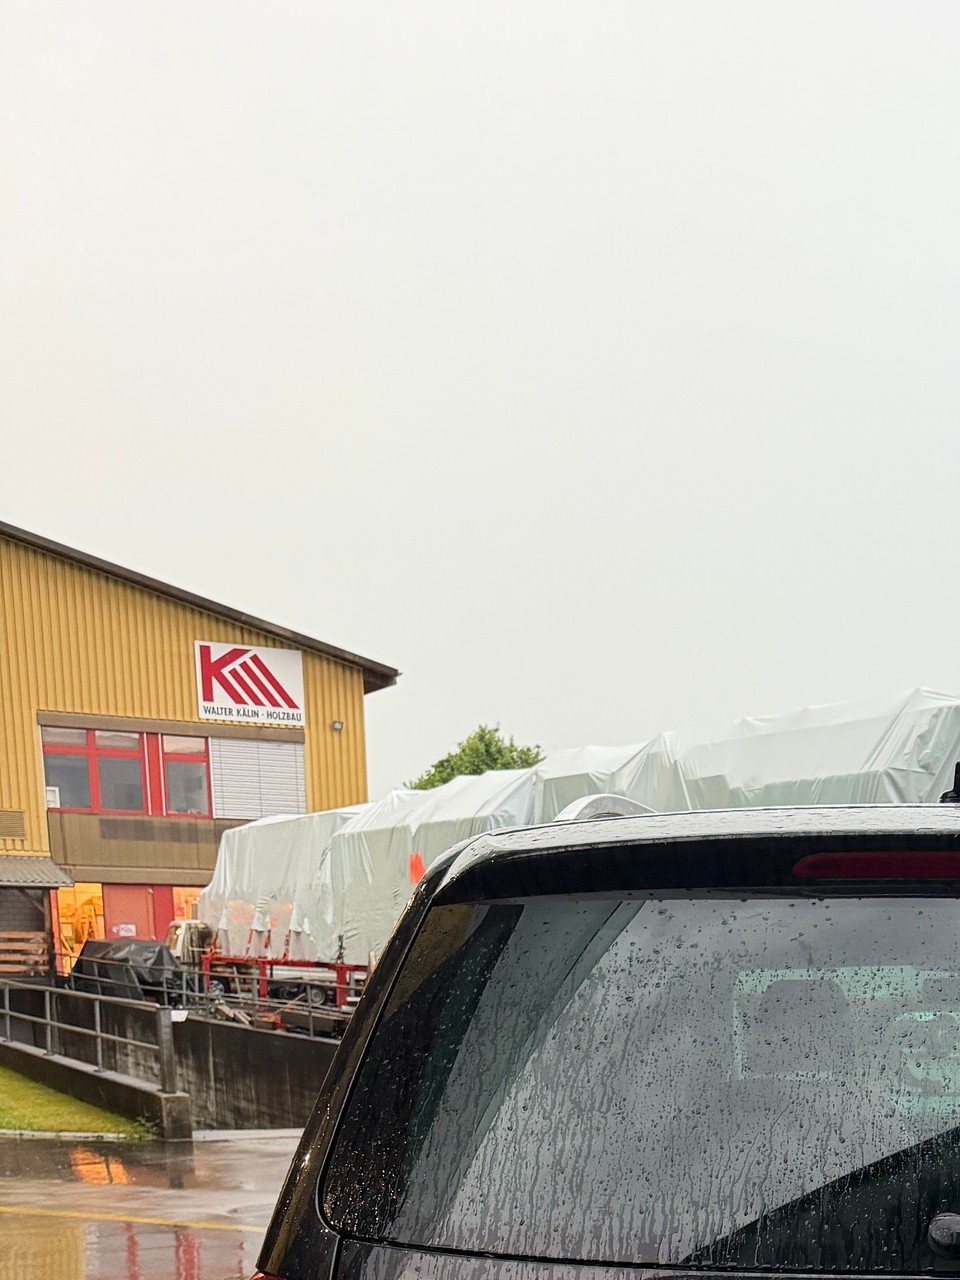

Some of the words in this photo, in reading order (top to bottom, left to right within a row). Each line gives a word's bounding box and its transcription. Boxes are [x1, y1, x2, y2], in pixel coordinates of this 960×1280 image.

[202, 705, 234, 717] WALTER
[236, 707, 260, 719] KÄLIN
[266, 710, 302, 721] HOLZBAU
